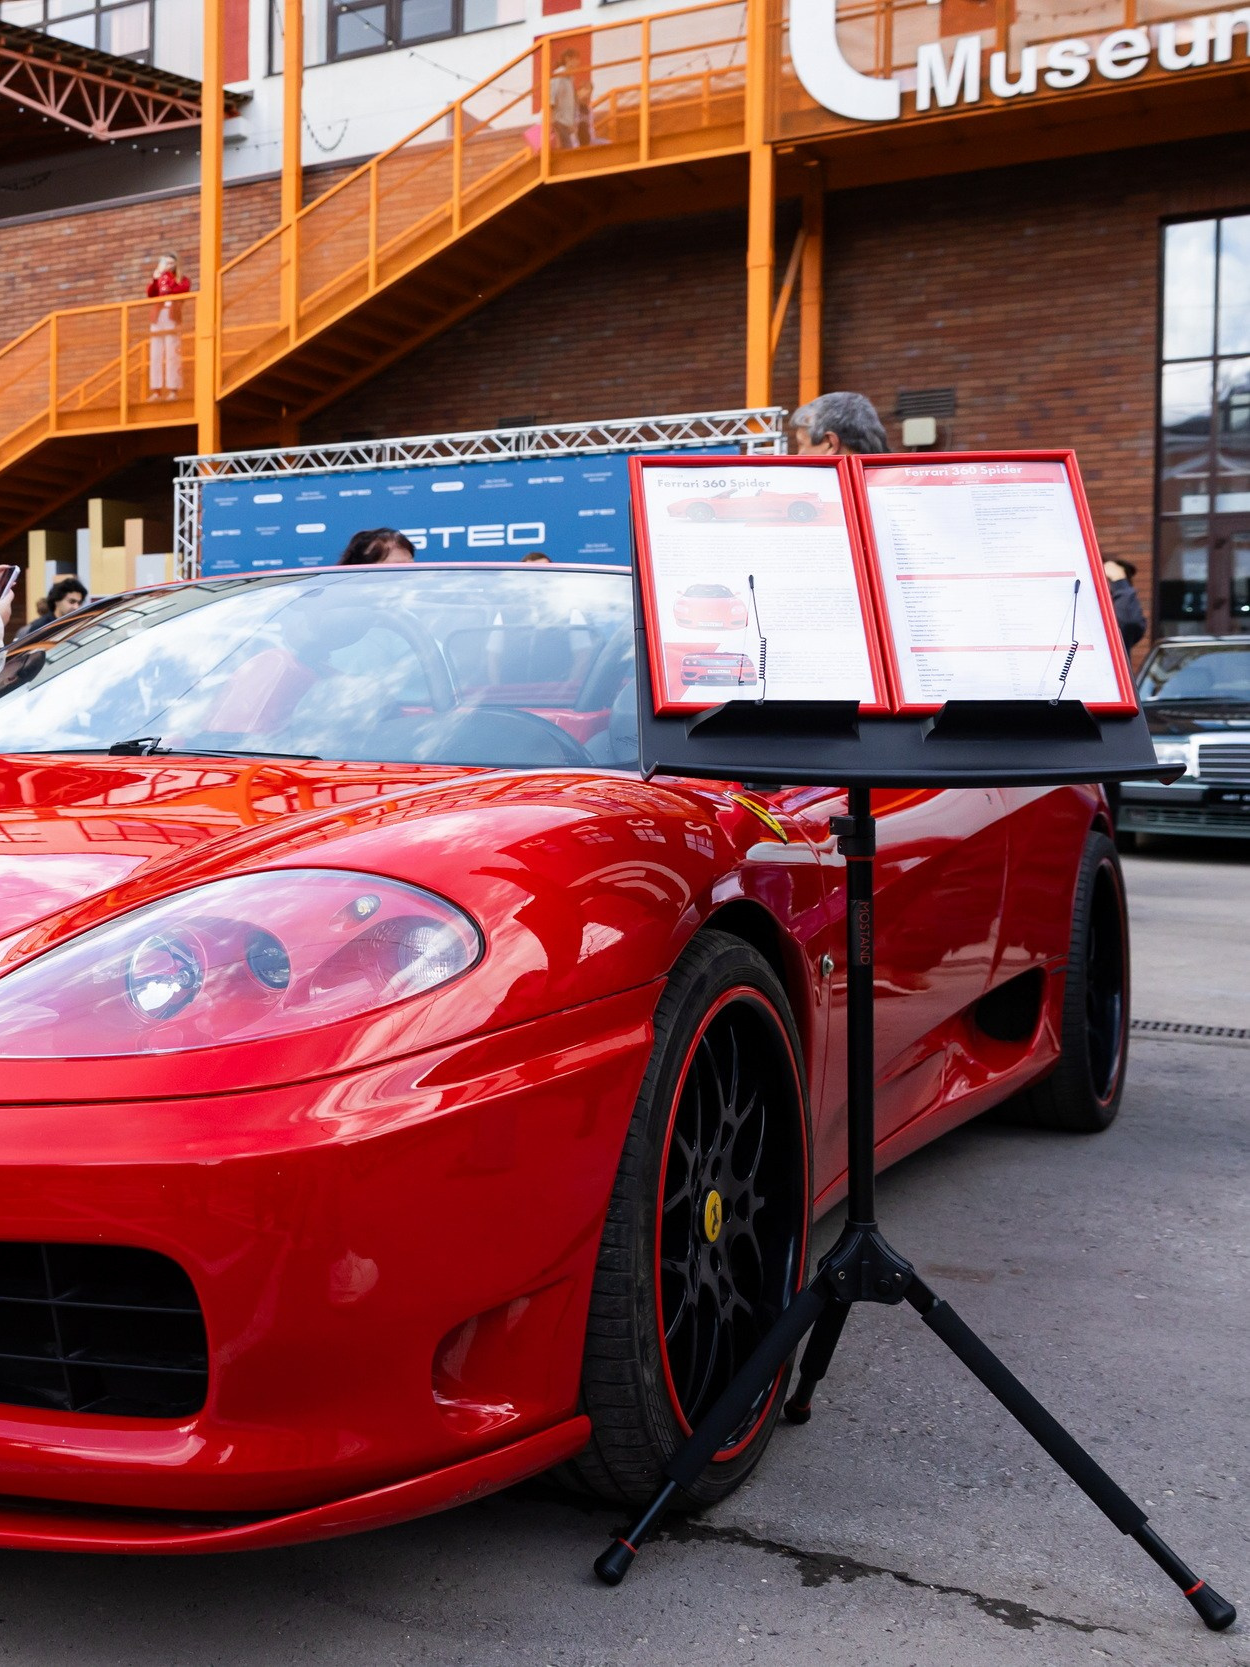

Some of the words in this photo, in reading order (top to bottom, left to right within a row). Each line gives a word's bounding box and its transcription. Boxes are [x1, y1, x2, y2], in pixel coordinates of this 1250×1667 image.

[904, 467, 949, 477] Ferrari
[952, 466, 978, 476] 360
[981, 464, 1023, 477] Spider
[657, 479, 700, 489] Ferrari
[703, 480, 727, 489] 360
[730, 478, 771, 490] Spider
[399, 521, 546, 551] STEO
[859, 901, 871, 965] MOSTAND
